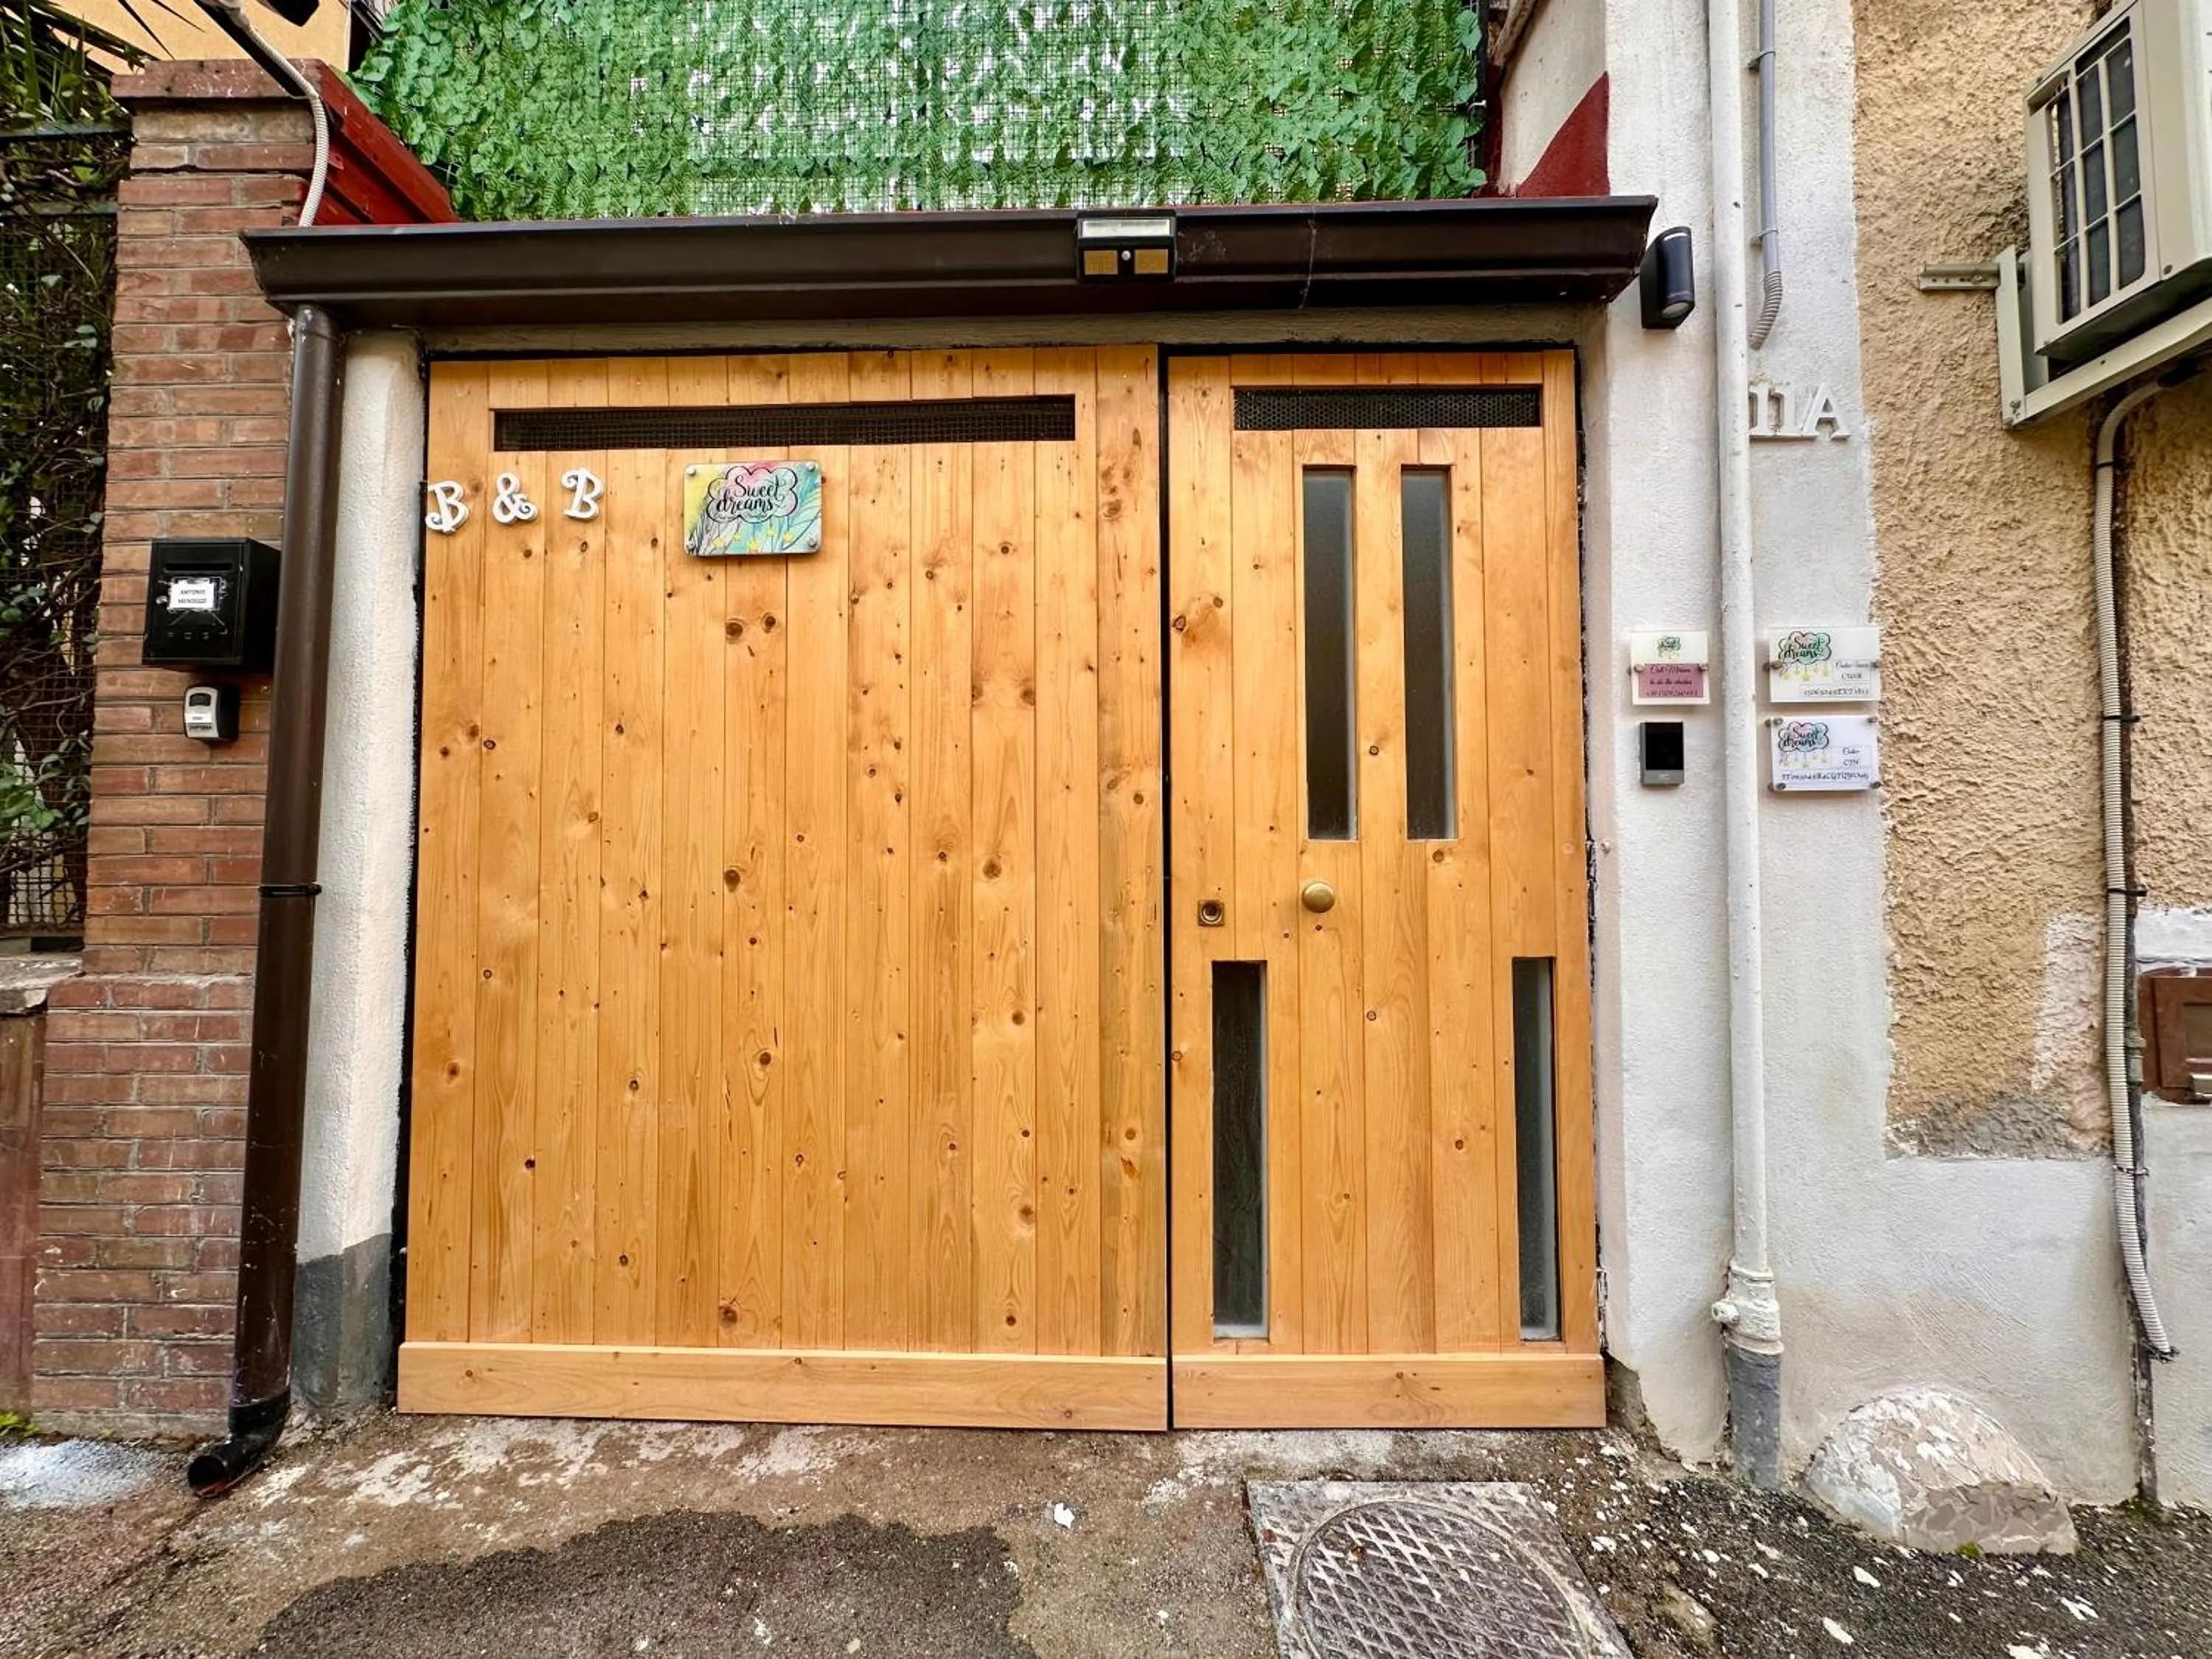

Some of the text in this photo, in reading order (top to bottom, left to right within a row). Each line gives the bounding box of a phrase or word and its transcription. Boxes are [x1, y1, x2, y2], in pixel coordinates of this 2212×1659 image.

[734, 475, 786, 501] Sweet
[425, 467, 604, 535] B & B
[716, 490, 774, 514] dreams
[1794, 635, 1822, 650] Sweet
[1783, 644, 1818, 660] dreams
[1792, 726, 1820, 739] Sweet
[1783, 734, 1817, 748] dreams
